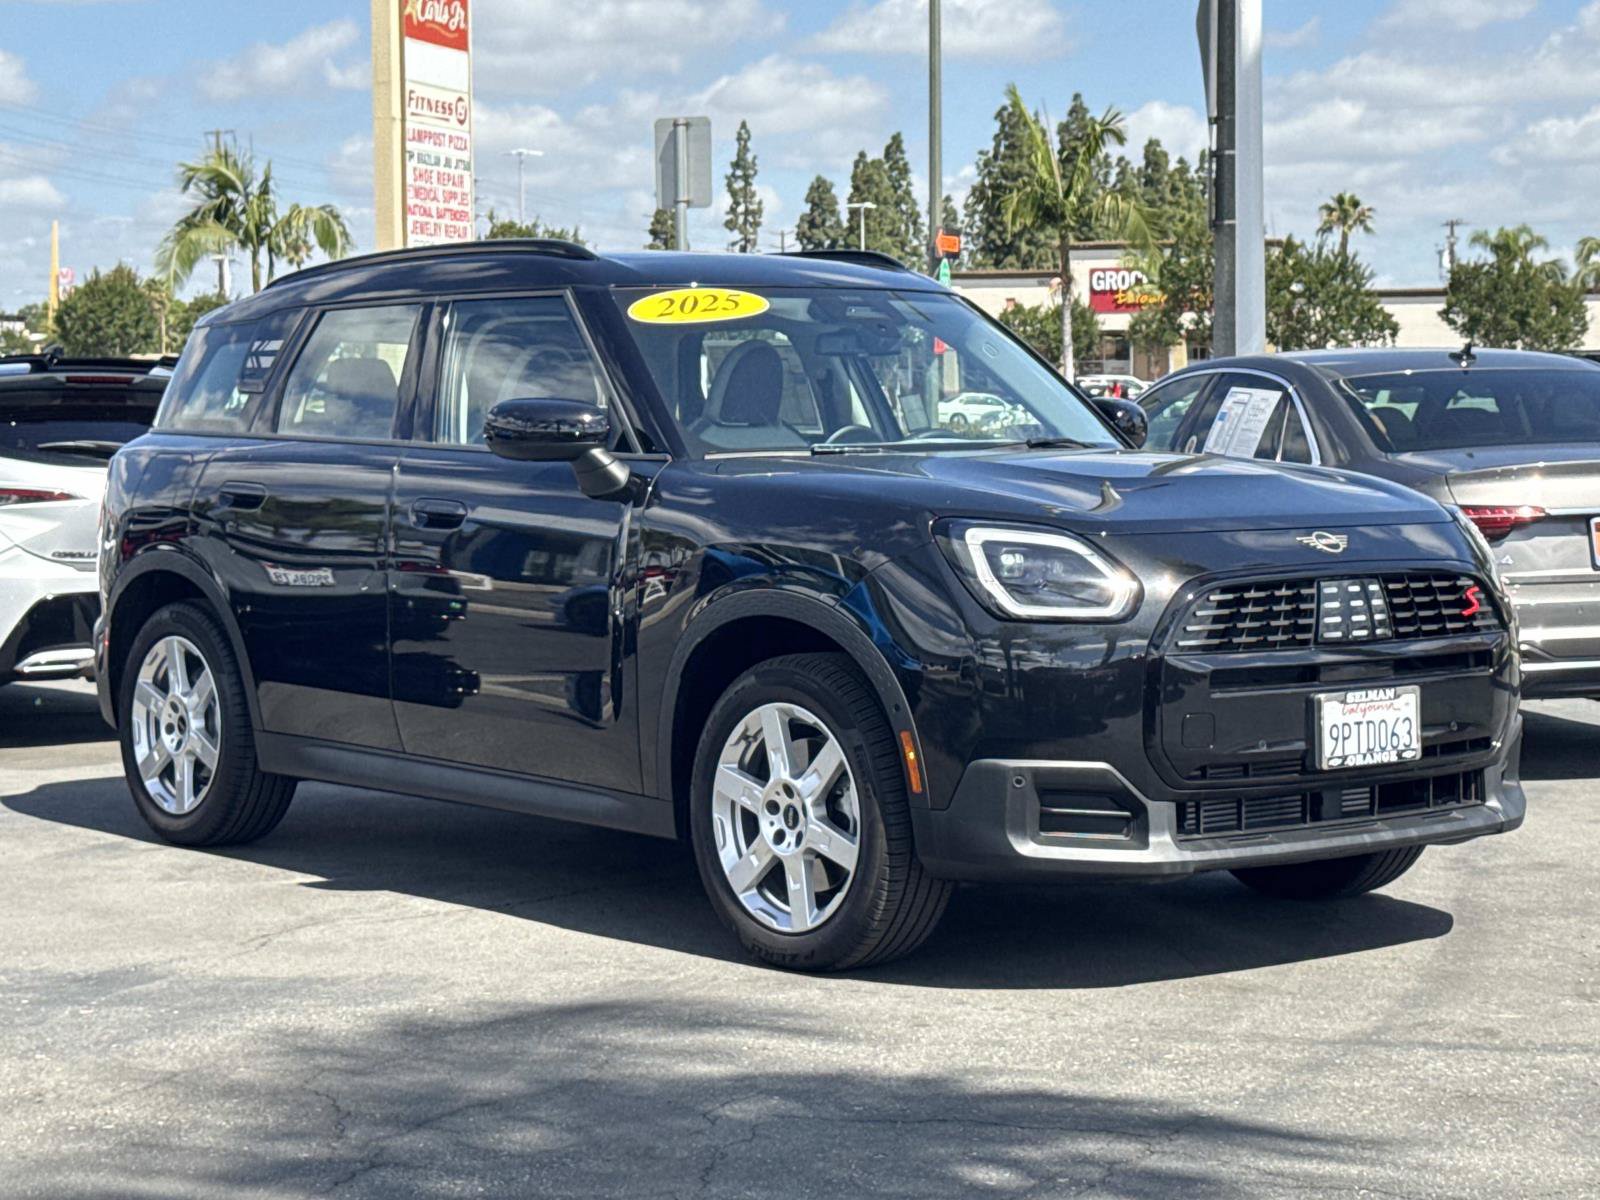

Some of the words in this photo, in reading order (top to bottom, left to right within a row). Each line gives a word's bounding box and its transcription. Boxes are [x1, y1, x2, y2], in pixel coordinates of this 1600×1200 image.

[448, 134, 468, 151] PIZZA
[413, 167, 433, 185] SHOE
[437, 171, 464, 188] REPAIR
[656, 294, 740, 318] 2025
[1329, 716, 1412, 757] 9PTD063
